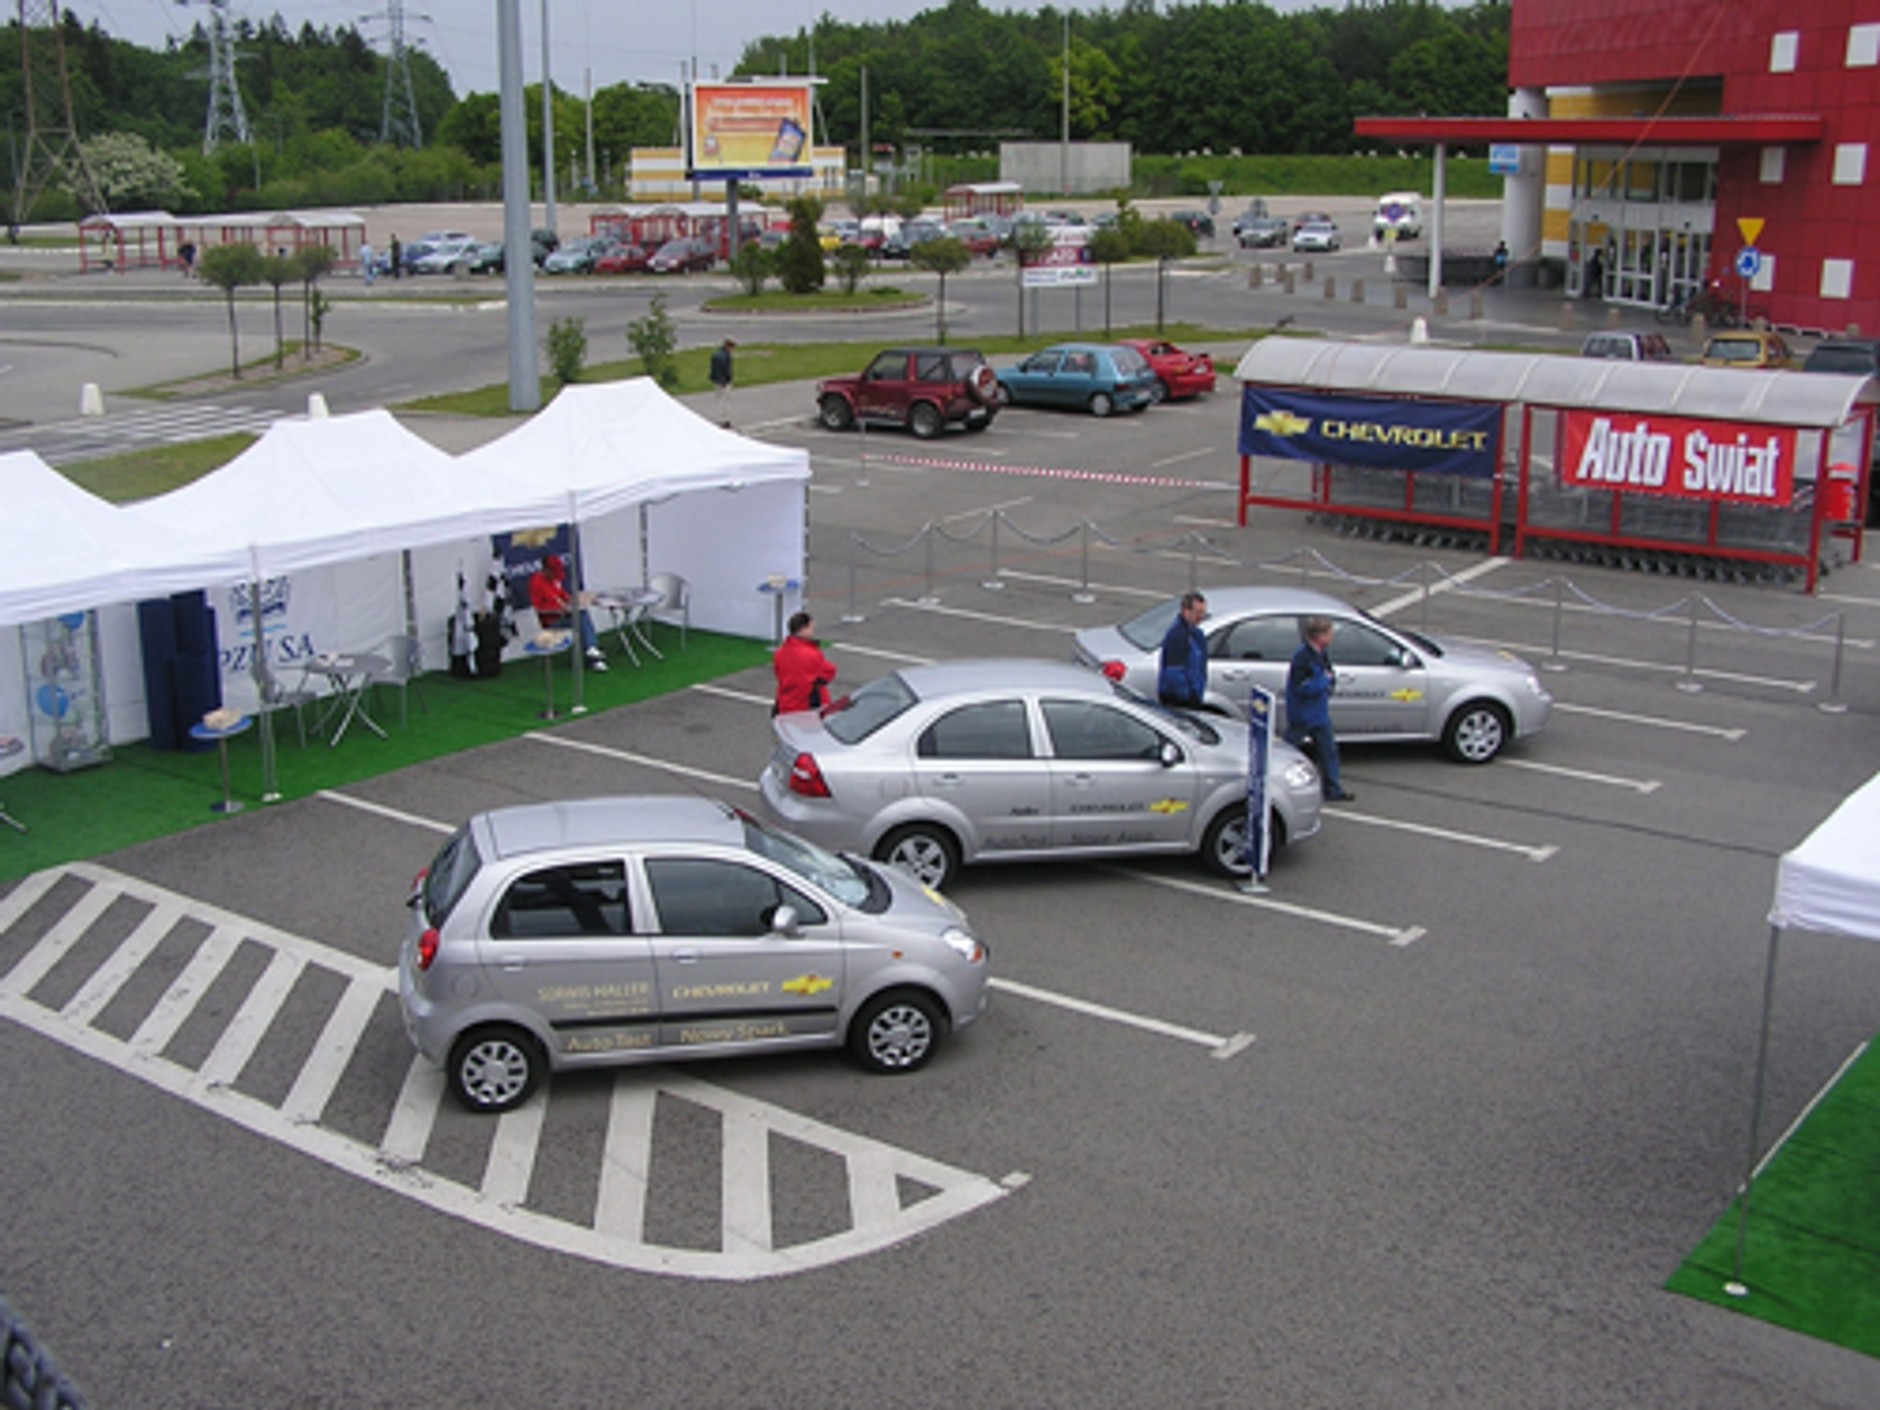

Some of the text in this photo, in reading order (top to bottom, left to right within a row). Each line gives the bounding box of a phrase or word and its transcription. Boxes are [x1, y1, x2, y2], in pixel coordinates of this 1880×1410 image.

[1321, 419, 1488, 450] CHEVROLET
[1576, 416, 1672, 487] Auto
[279, 633, 315, 663] SA
[672, 980, 770, 999] CHEVROLET
